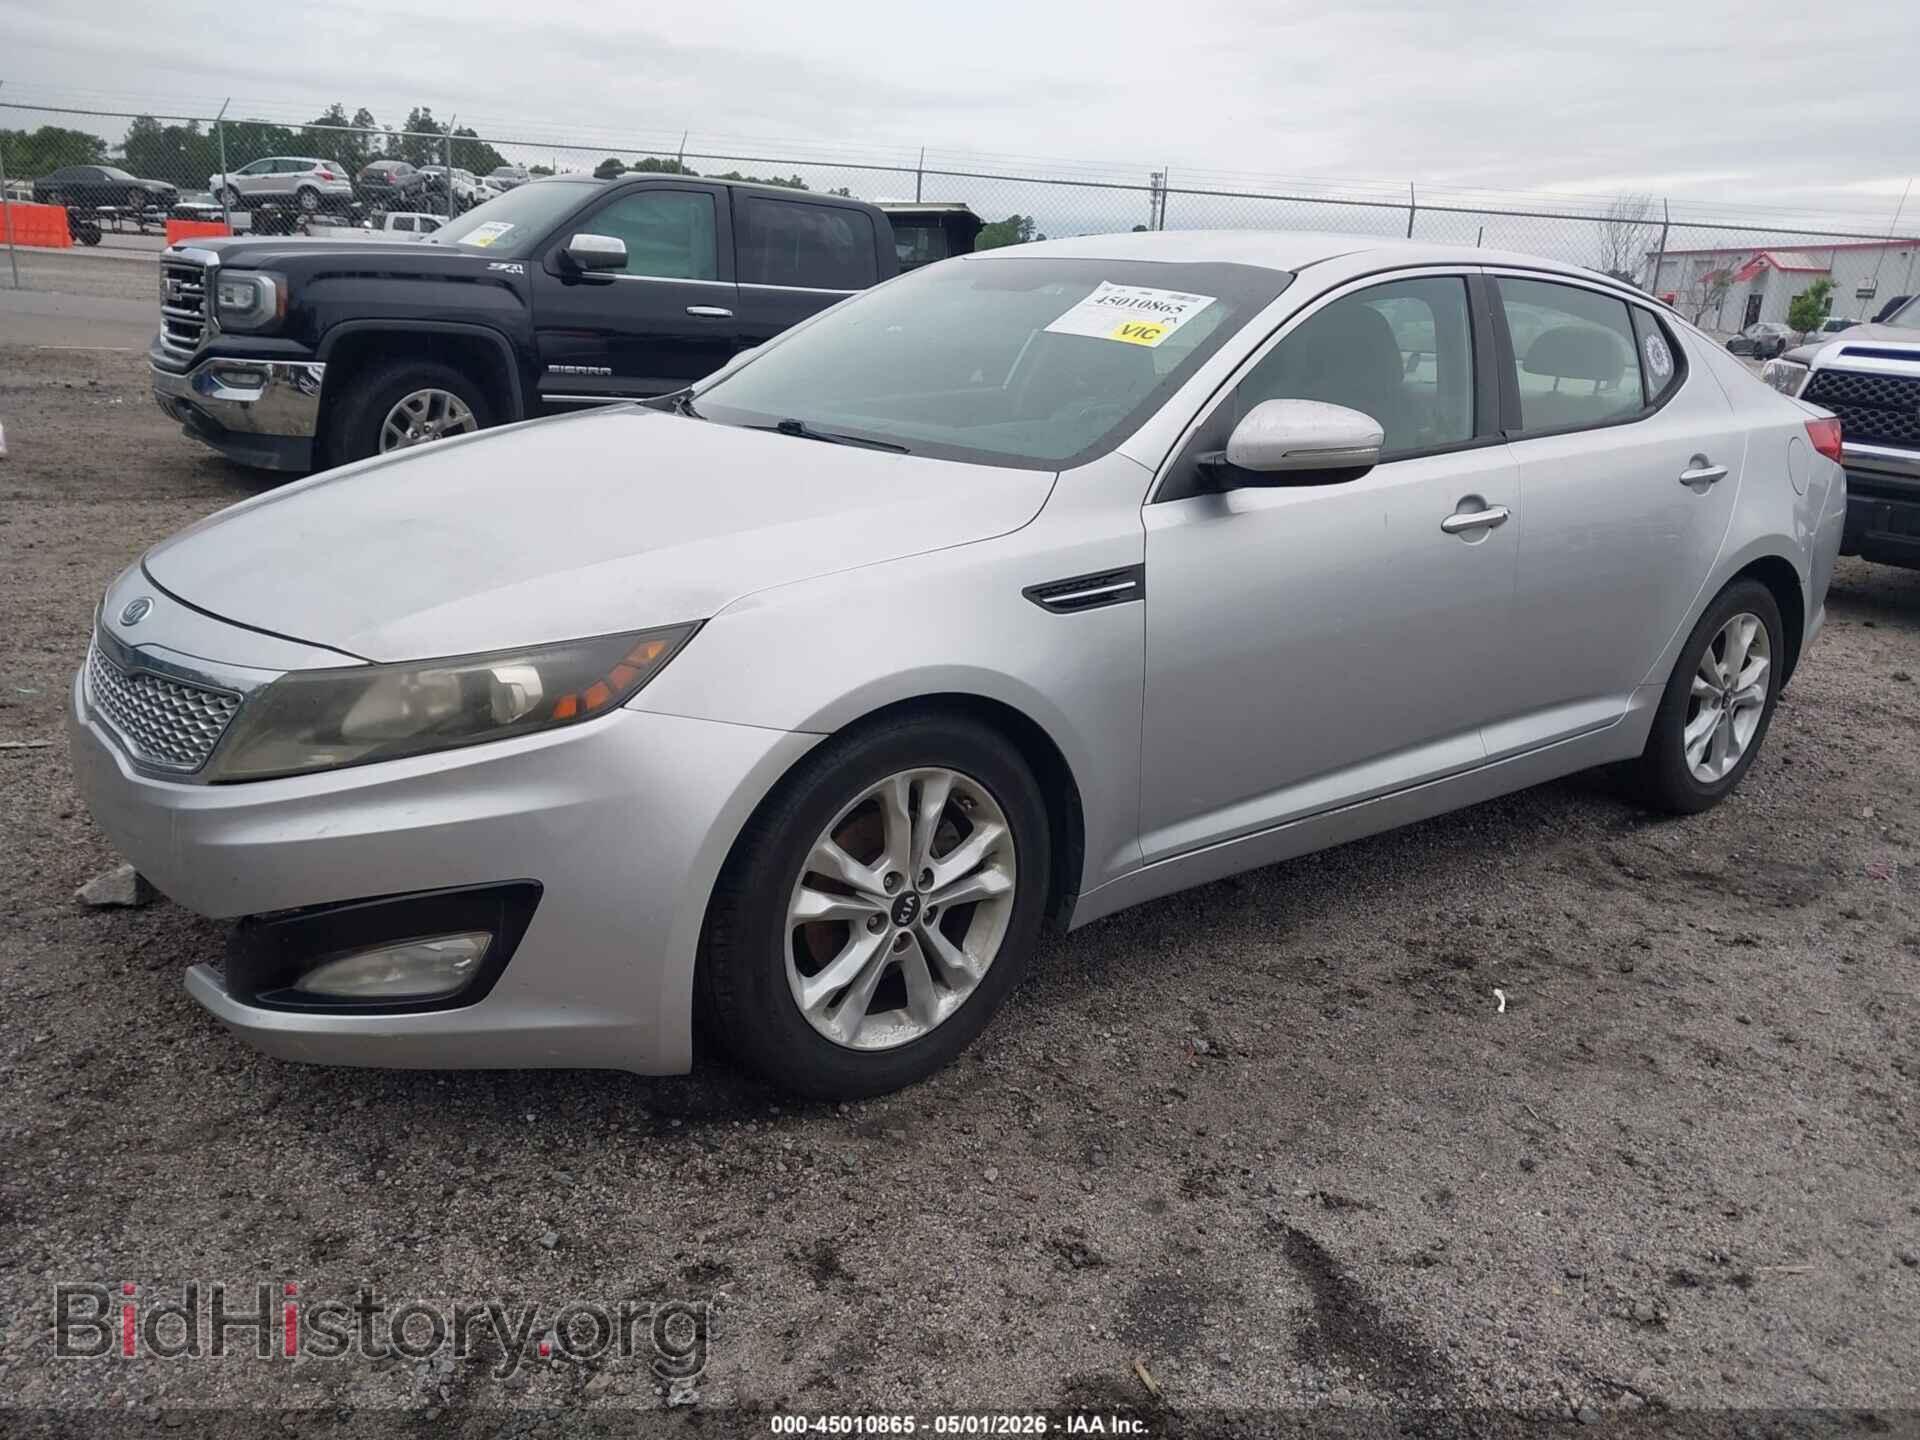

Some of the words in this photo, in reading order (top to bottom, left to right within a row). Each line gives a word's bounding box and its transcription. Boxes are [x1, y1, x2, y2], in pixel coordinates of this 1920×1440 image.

[1095, 295, 1187, 314] 45010865
[1120, 323, 1161, 340] VIC
[548, 365, 612, 376] SIERRA
